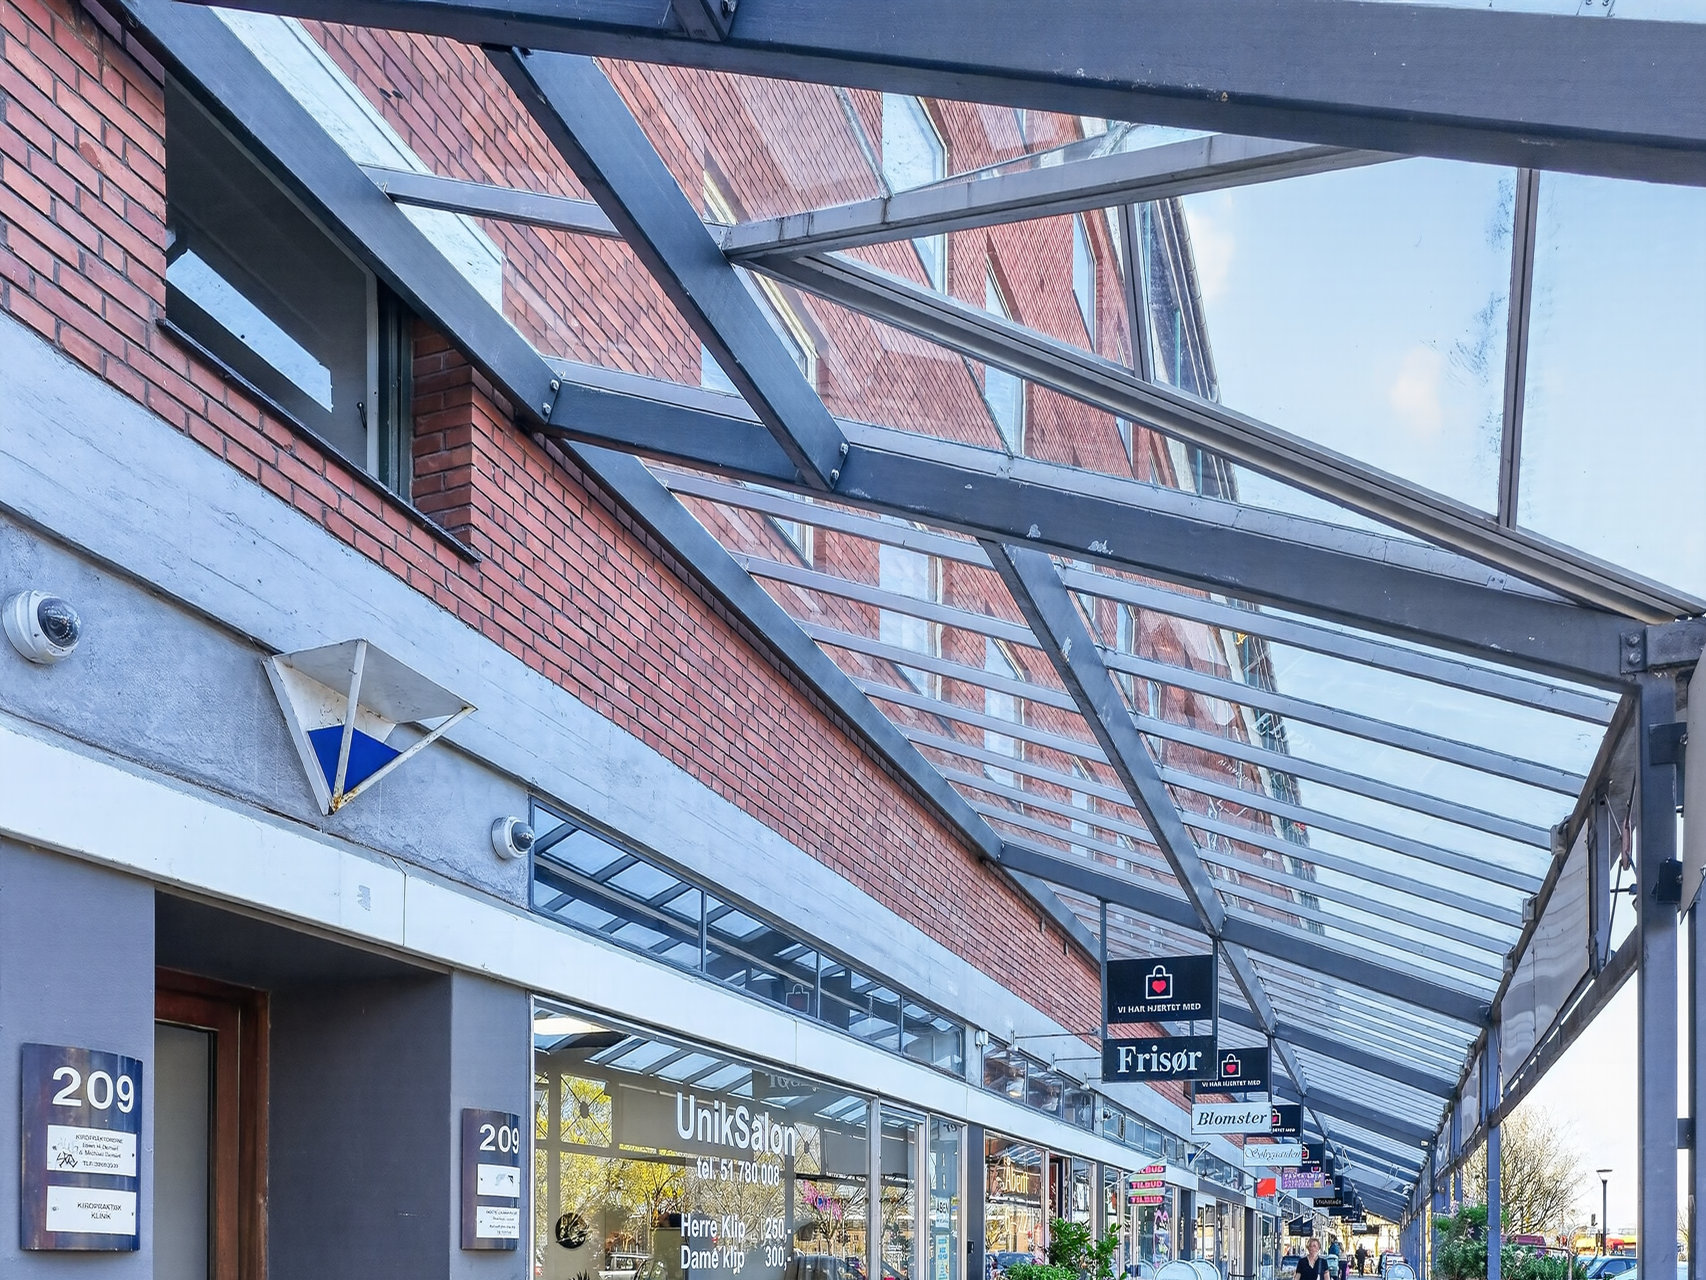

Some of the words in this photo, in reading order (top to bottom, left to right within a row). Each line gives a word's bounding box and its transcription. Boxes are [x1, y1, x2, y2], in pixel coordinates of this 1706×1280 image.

[1128, 1005, 1145, 1013] HAR
[1147, 1004, 1180, 1012] HJERTET
[1182, 1003, 1201, 1011] MED
[1117, 1045, 1202, 1074] Frisør
[52, 1066, 134, 1113] 209
[676, 1091, 796, 1157] UnikSalon
[1197, 1110, 1268, 1126] Blomster
[479, 1123, 519, 1154] 209
[697, 1156, 716, 1180] tel.
[721, 1158, 734, 1181] 51
[739, 1160, 758, 1184] 780
[761, 1163, 780, 1186] 008
[1131, 1180, 1163, 1189] TILBUD
[1130, 1195, 1163, 1203] TILBUD
[680, 1212, 717, 1238] Herre
[721, 1214, 746, 1243] Klip
[680, 1245, 719, 1269] Dame
[722, 1245, 745, 1273] klip
[764, 1245, 792, 1271] 300,-
